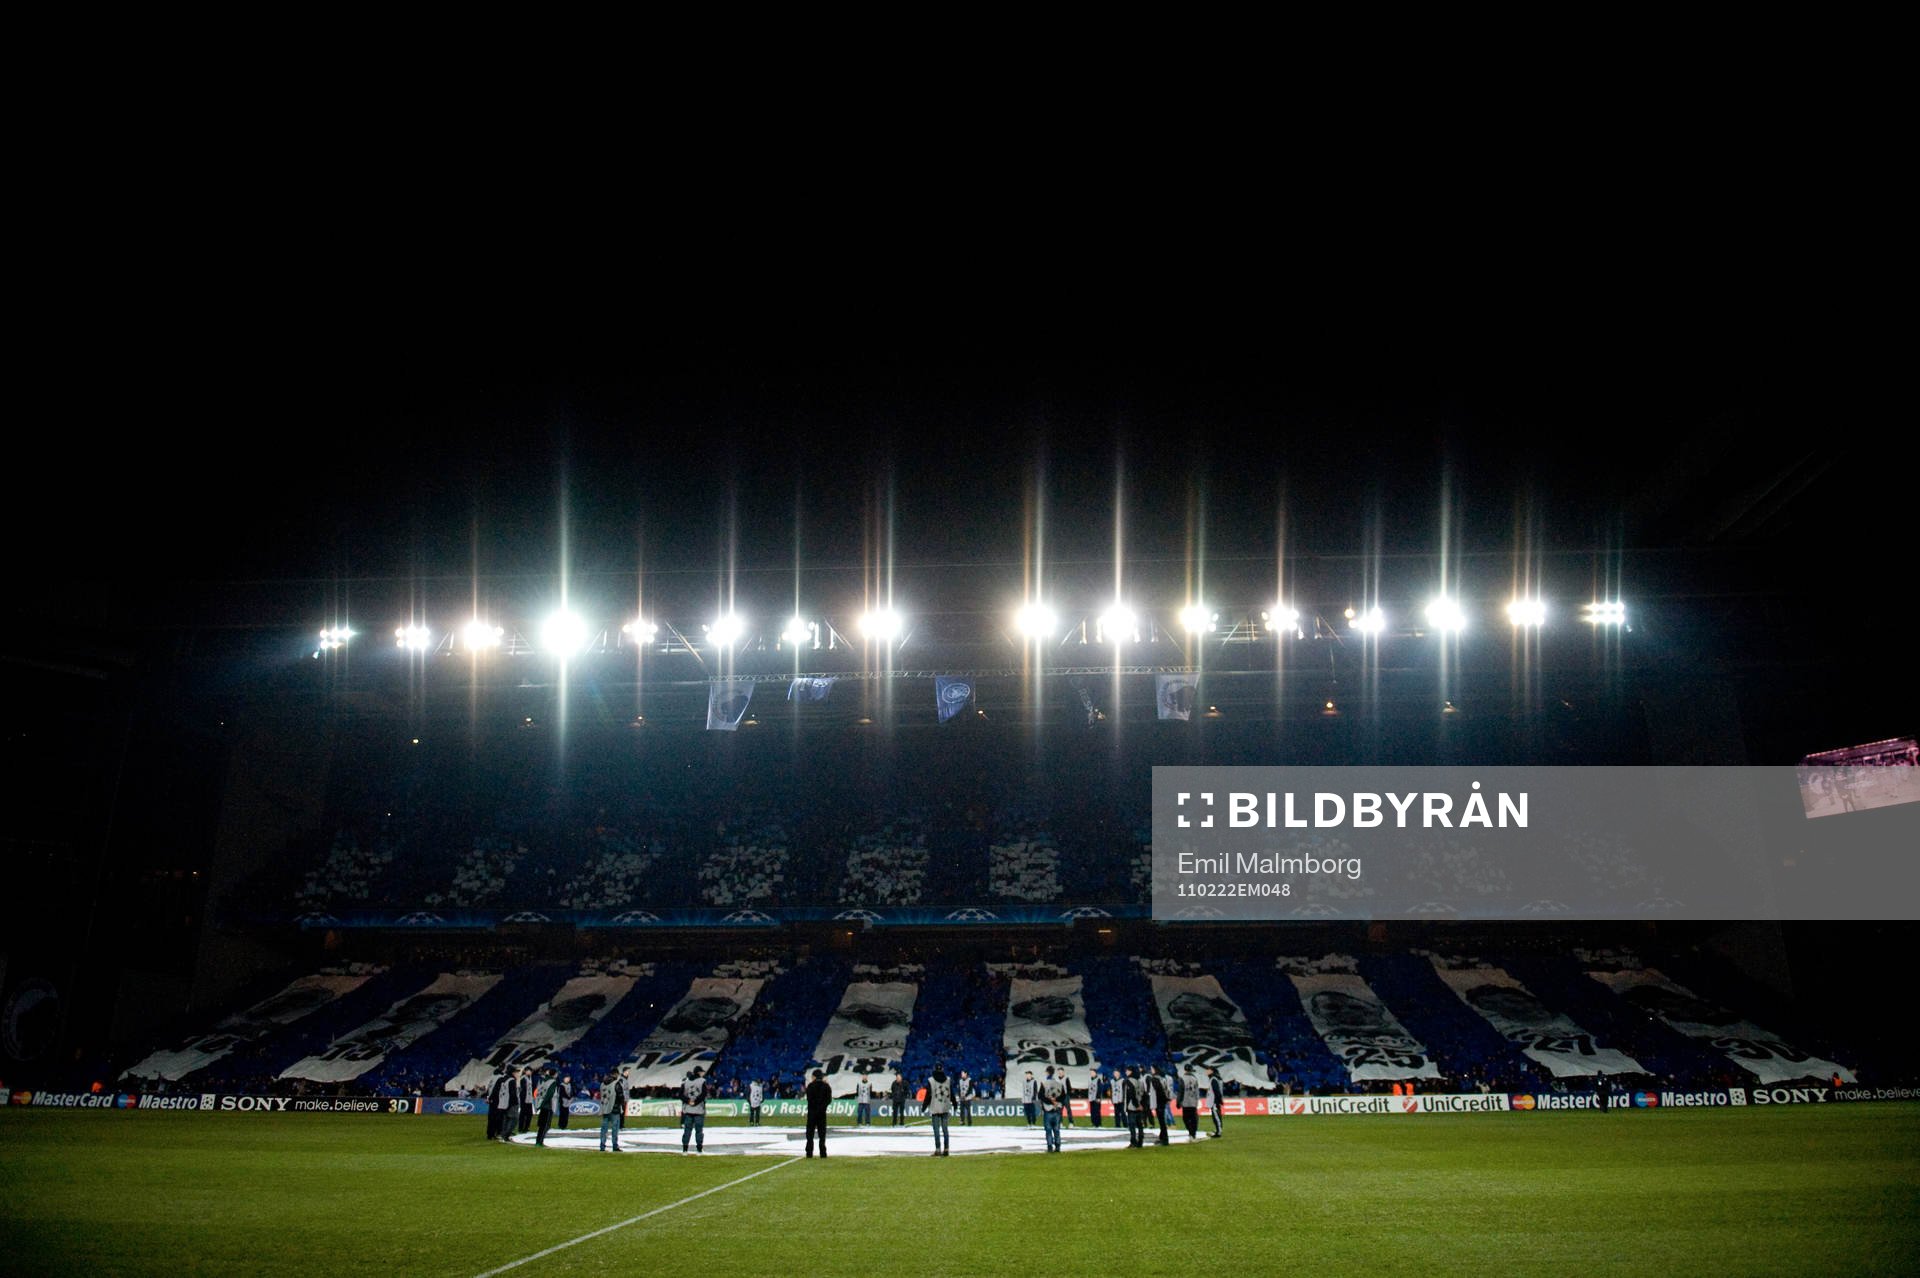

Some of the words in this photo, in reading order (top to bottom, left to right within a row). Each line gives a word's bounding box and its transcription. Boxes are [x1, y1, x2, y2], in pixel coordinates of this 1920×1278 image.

[821, 1055, 888, 1075] 18
[1017, 1047, 1090, 1067] 20
[32, 1091, 115, 1108] MasterCard
[138, 1094, 198, 1110] Maestro
[1423, 1096, 1504, 1112] UniCredit
[1661, 1091, 1727, 1106] Maestro
[1752, 1088, 1829, 1104] SONY
[220, 1096, 291, 1111] SONY
[295, 1098, 379, 1112] make.believe
[388, 1099, 409, 1113] 3D
[447, 1102, 469, 1113] Ford
[573, 1103, 596, 1114] Ford
[741, 1102, 777, 1116] Eoy
[780, 1101, 856, 1116] Respsibly
[971, 1105, 1025, 1117] LEAGUE
[1310, 1098, 1391, 1114] UniCredit
